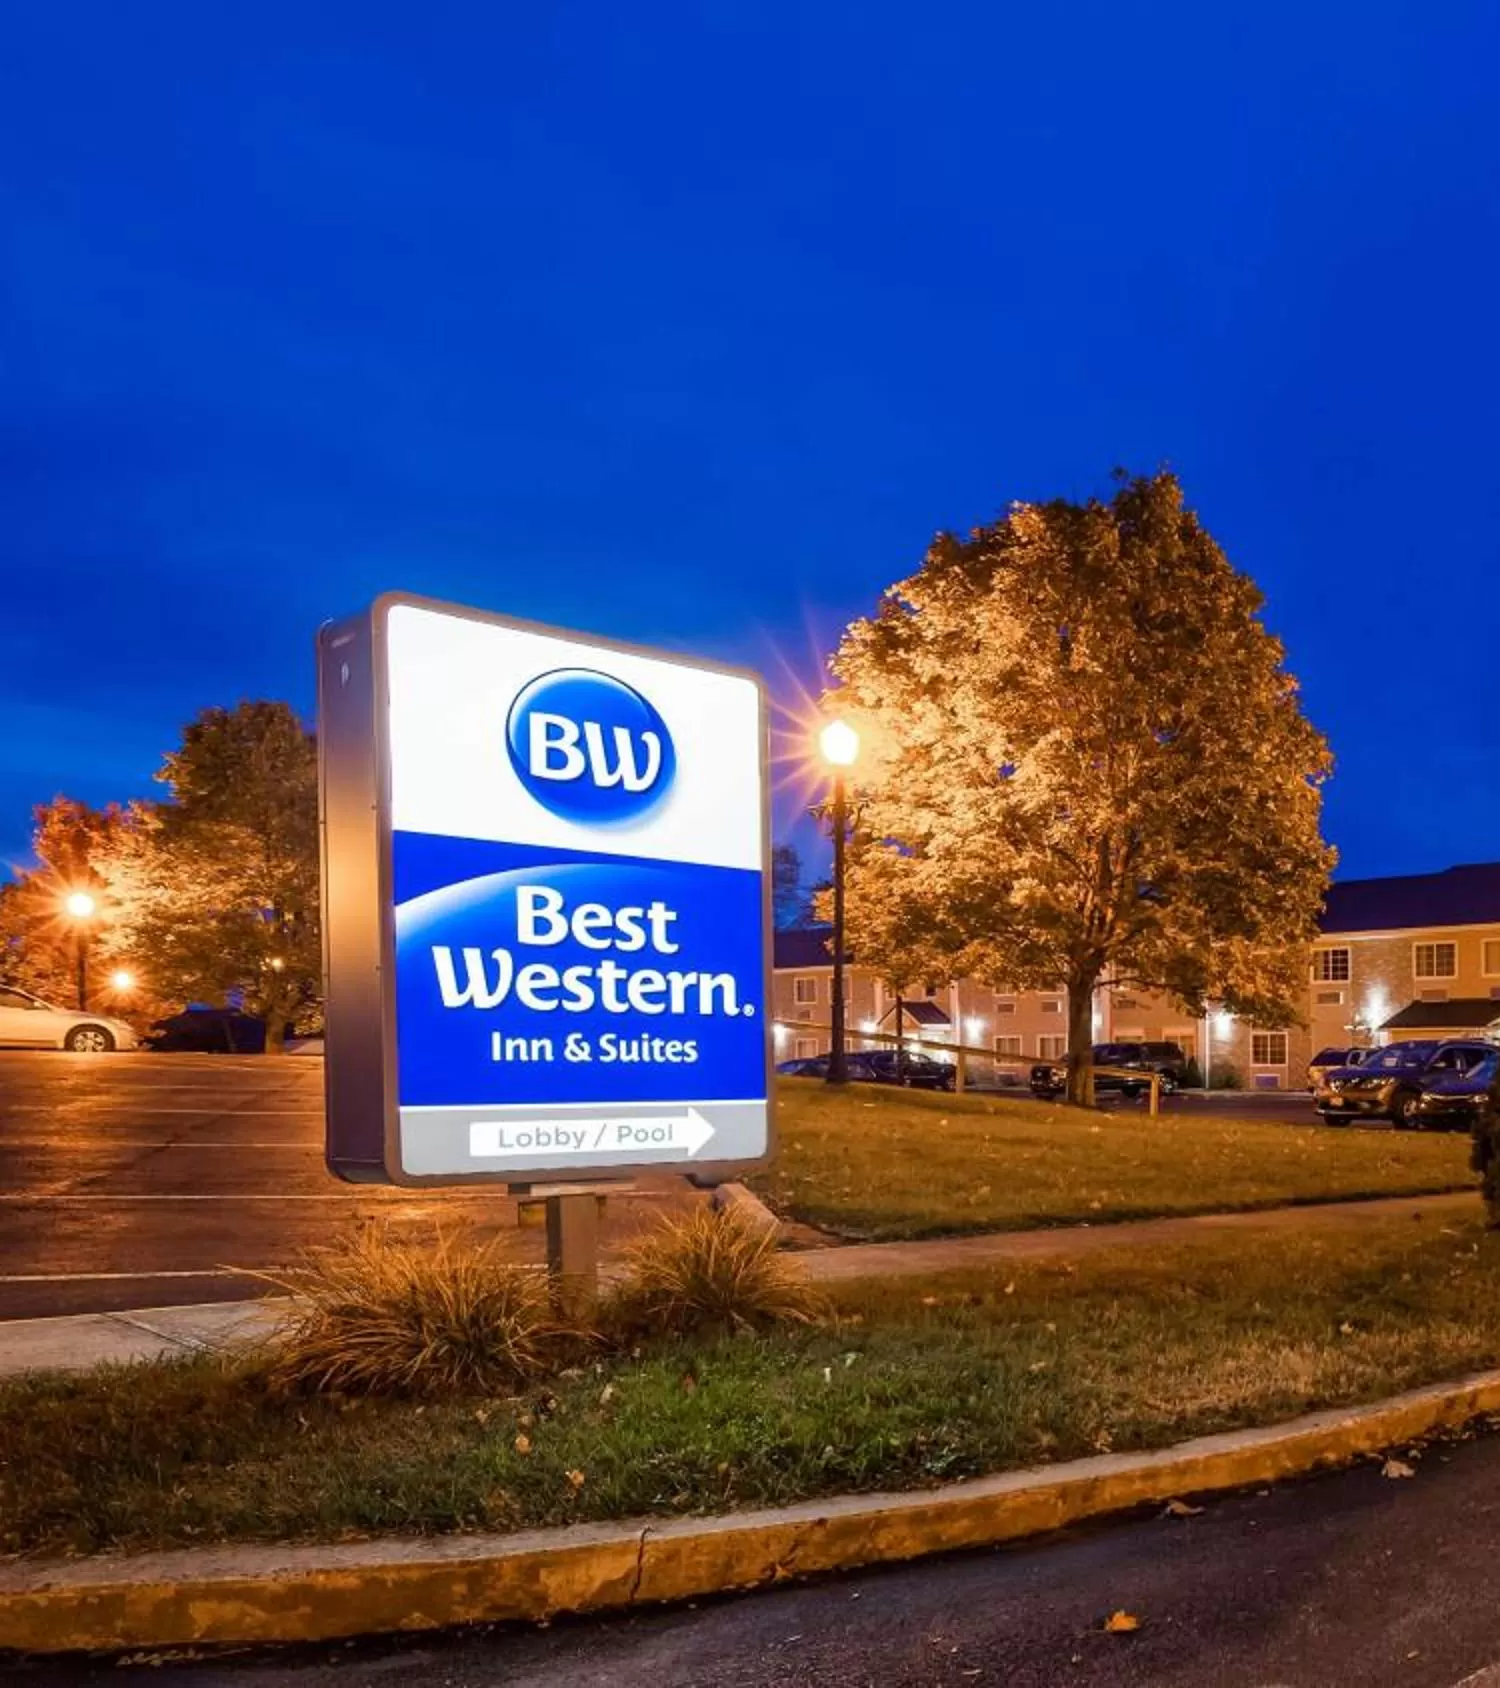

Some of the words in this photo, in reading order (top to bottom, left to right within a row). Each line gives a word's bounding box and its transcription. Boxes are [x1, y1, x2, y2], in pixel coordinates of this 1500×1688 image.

[529, 712, 662, 792] BW
[515, 885, 679, 954] Best
[491, 1032, 554, 1061] Inn
[564, 1033, 592, 1063] &
[599, 1033, 699, 1064] Suites
[498, 1125, 585, 1150] Lobby
[593, 1123, 607, 1148] /
[616, 1123, 673, 1144] Pool
